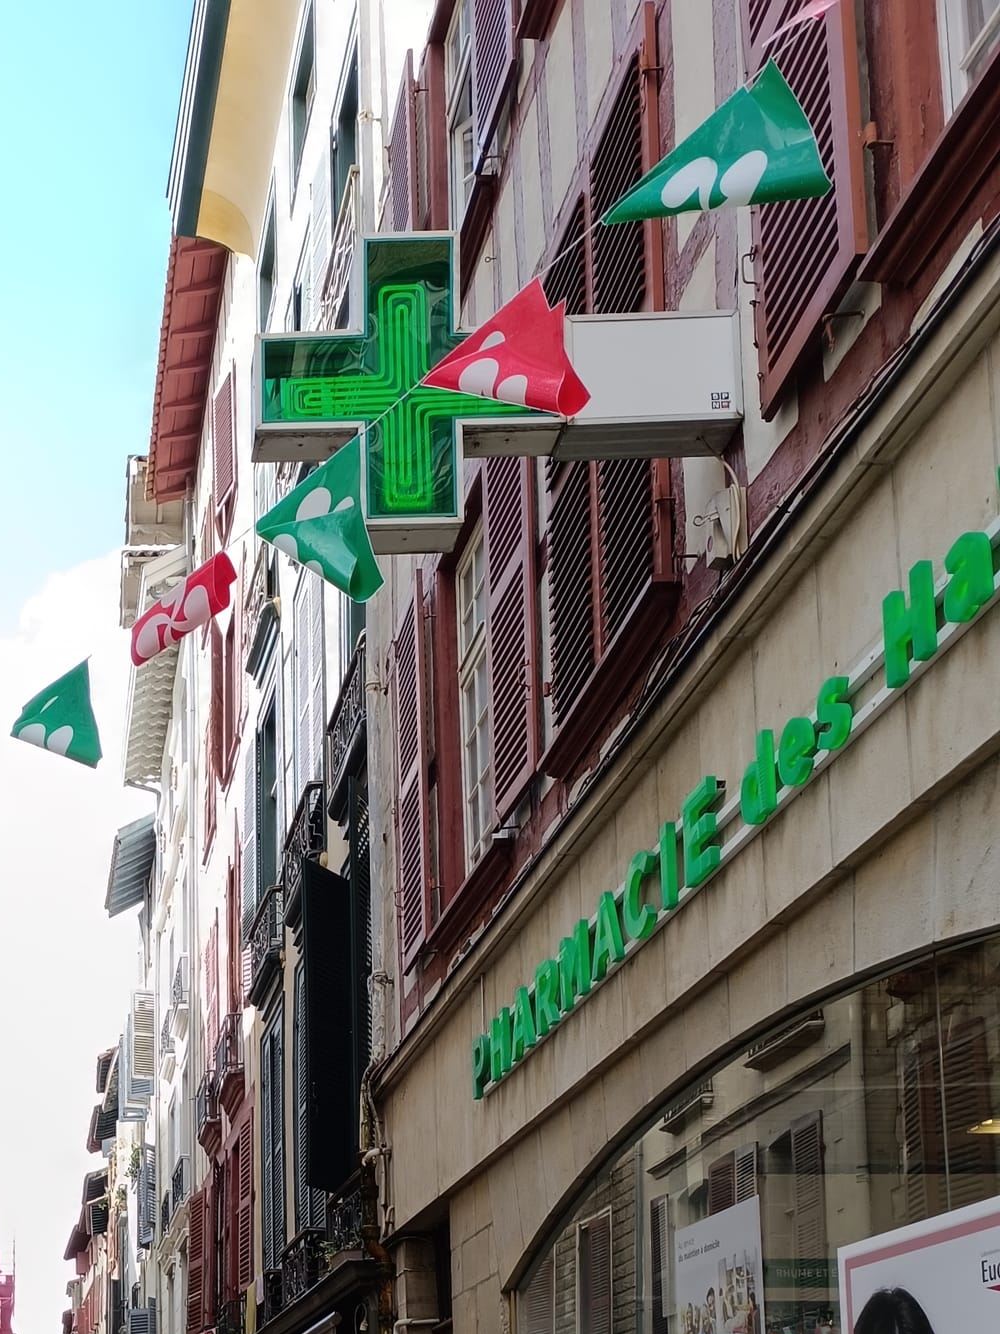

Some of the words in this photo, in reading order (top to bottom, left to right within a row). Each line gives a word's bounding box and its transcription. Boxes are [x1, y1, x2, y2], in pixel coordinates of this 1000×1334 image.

[472, 776, 722, 1100] PHARMACIE
[740, 676, 853, 826] des
[882, 531, 995, 688] Ha
[775, 1268, 814, 1278] RHUME
